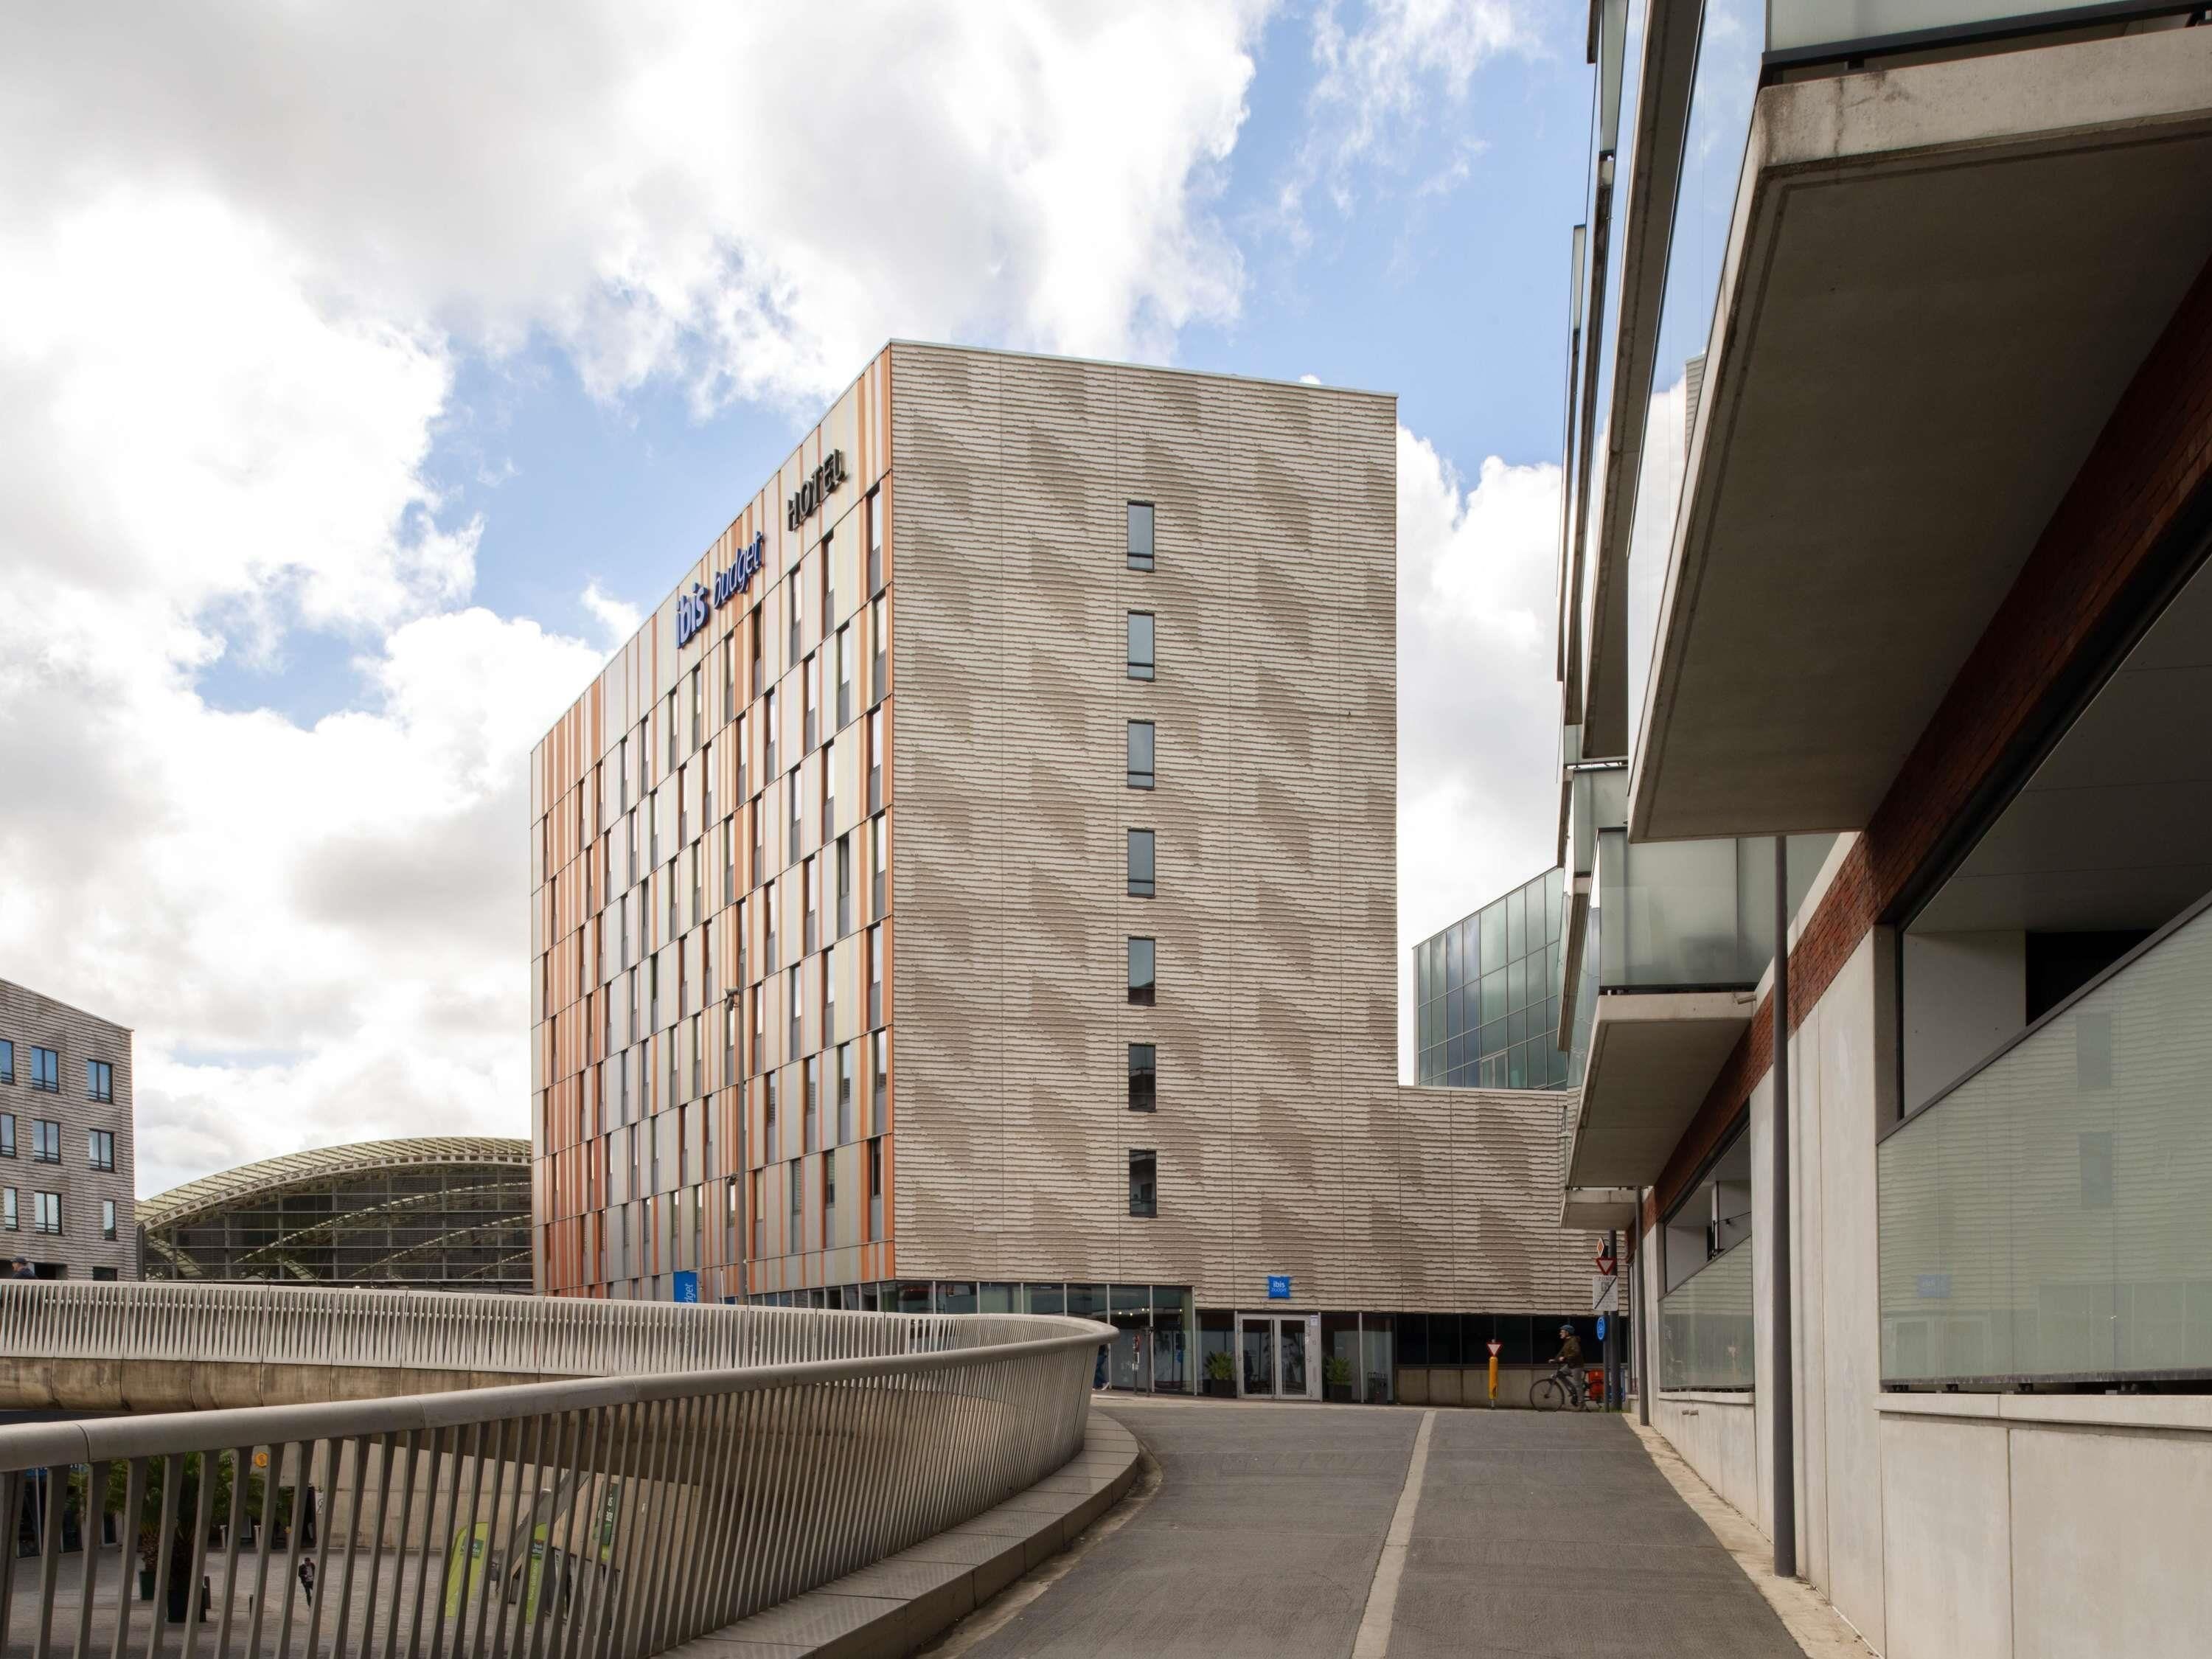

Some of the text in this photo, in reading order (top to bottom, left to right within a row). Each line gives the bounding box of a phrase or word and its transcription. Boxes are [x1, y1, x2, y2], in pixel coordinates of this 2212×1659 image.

[787, 449, 847, 532] HOTEL
[675, 530, 765, 650] ibis budget
[684, 1283, 696, 1303] dget
